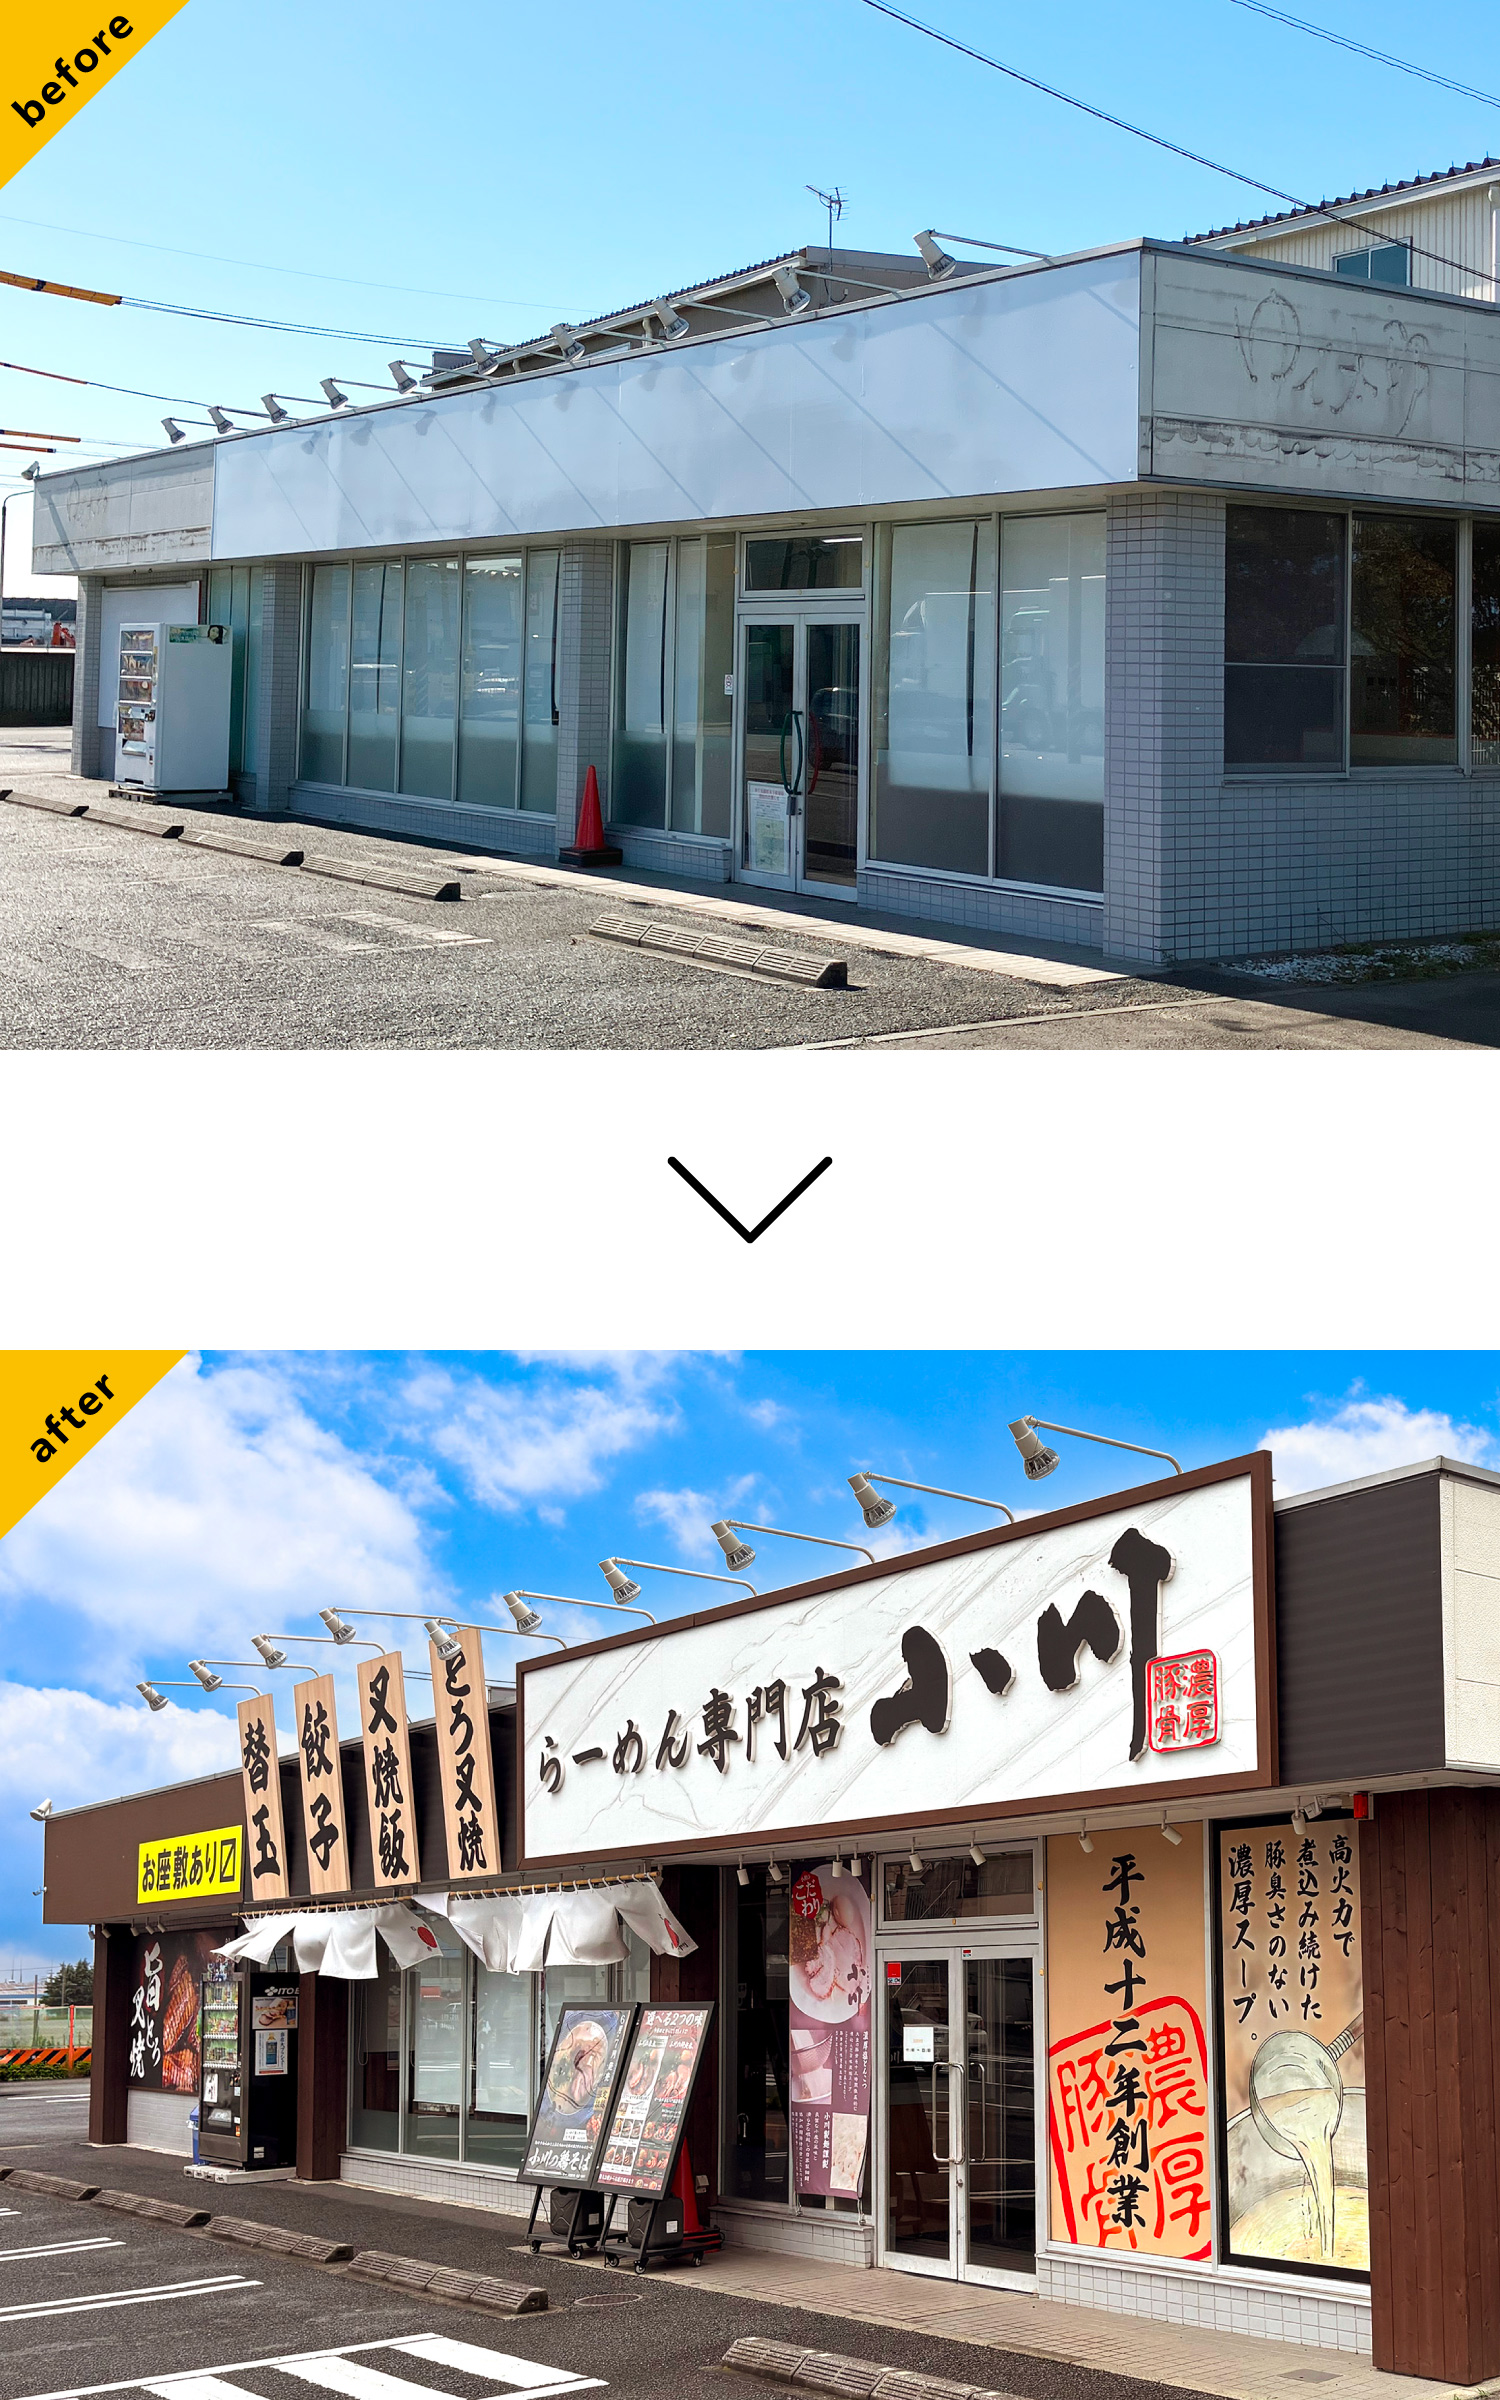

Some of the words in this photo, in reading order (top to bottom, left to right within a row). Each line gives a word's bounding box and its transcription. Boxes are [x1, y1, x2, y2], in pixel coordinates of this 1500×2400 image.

[539, 1667, 842, 1793] らーめん専門店
[869, 1527, 1176, 1762] 小川
[1154, 1663, 1181, 1742] 豚骨
[1182, 1658, 1213, 1738] 濃厚
[243, 1718, 281, 1879] 替玉
[301, 1700, 339, 1871] 餃子
[368, 1665, 409, 1879] 叉焼飯
[1228, 1843, 1257, 2041] 濃厚スープ。
[1264, 1840, 1289, 2019] 豚臭さのない
[1296, 1838, 1322, 2021] 煮込み続けた
[1329, 1834, 1355, 1957] 高火力で
[645, 2011, 704, 2027] 選べる2つの味
[1102, 1853, 1150, 2228] 平成十二年創業
